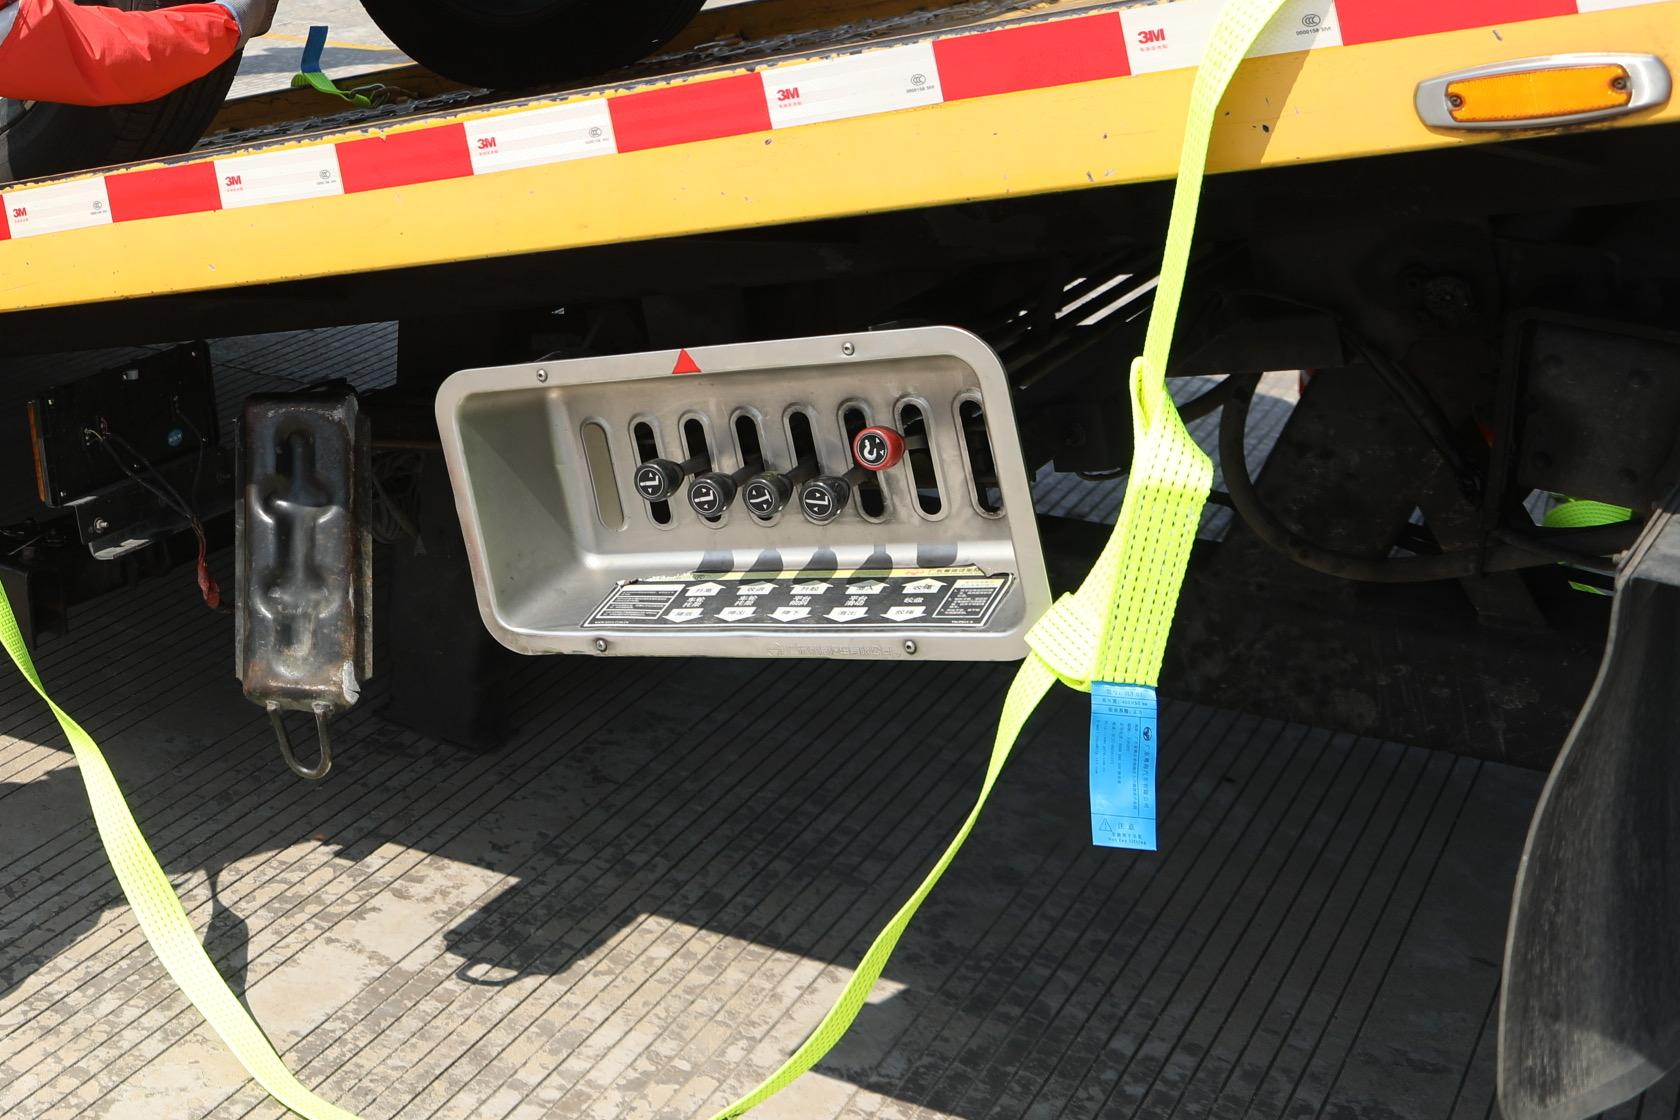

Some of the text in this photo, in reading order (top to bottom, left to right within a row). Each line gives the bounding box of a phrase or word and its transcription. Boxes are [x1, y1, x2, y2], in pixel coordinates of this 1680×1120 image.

[1137, 28, 1166, 45] 3M
[777, 87, 800, 102] 3M
[477, 136, 497, 150] 3M
[225, 175, 242, 186] 3M
[13, 207, 27, 218] 3M
